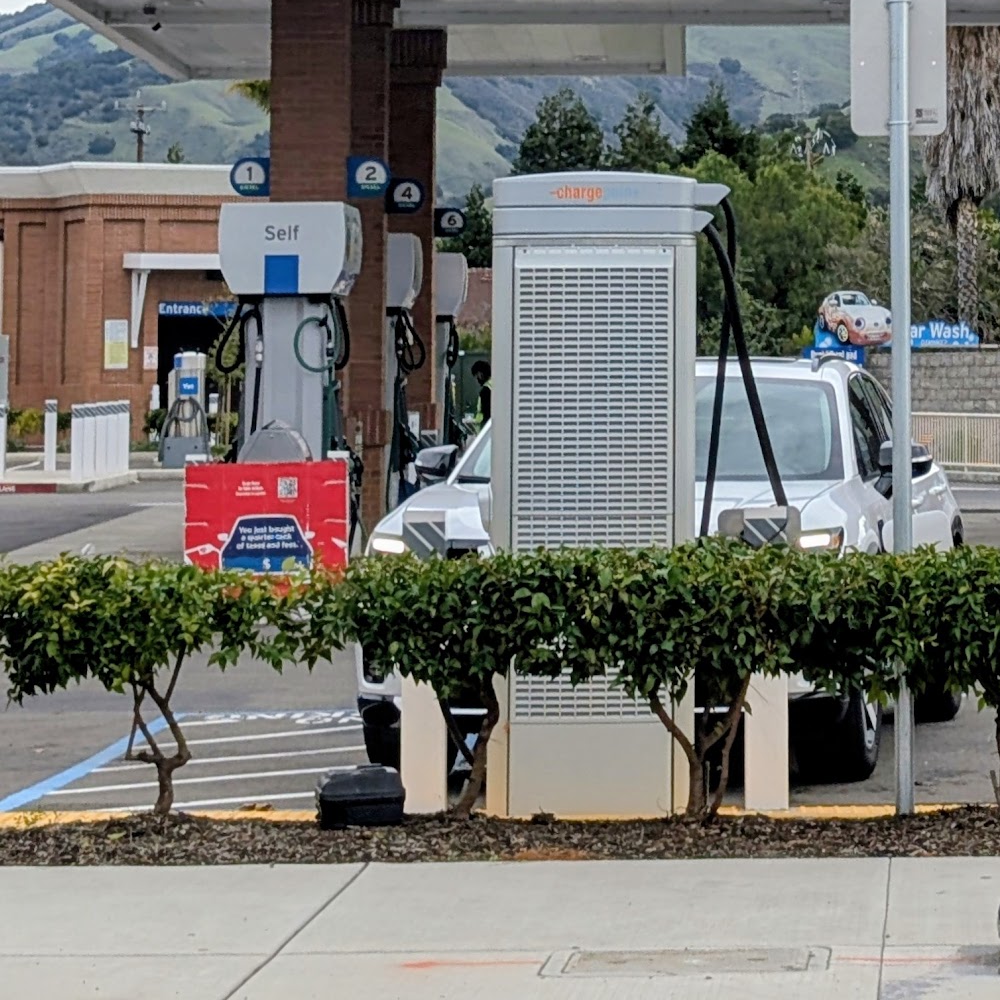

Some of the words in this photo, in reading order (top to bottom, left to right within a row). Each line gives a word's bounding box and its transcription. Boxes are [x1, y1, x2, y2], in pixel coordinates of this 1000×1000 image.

[246, 166, 253, 181] 1
[365, 166, 377, 180] 2
[401, 187, 412, 199] 4
[447, 215, 457, 226] 6
[264, 224, 299, 241] Self
[910, 324, 926, 339] ar
[929, 320, 970, 339] Wash
[239, 526, 253, 534] You
